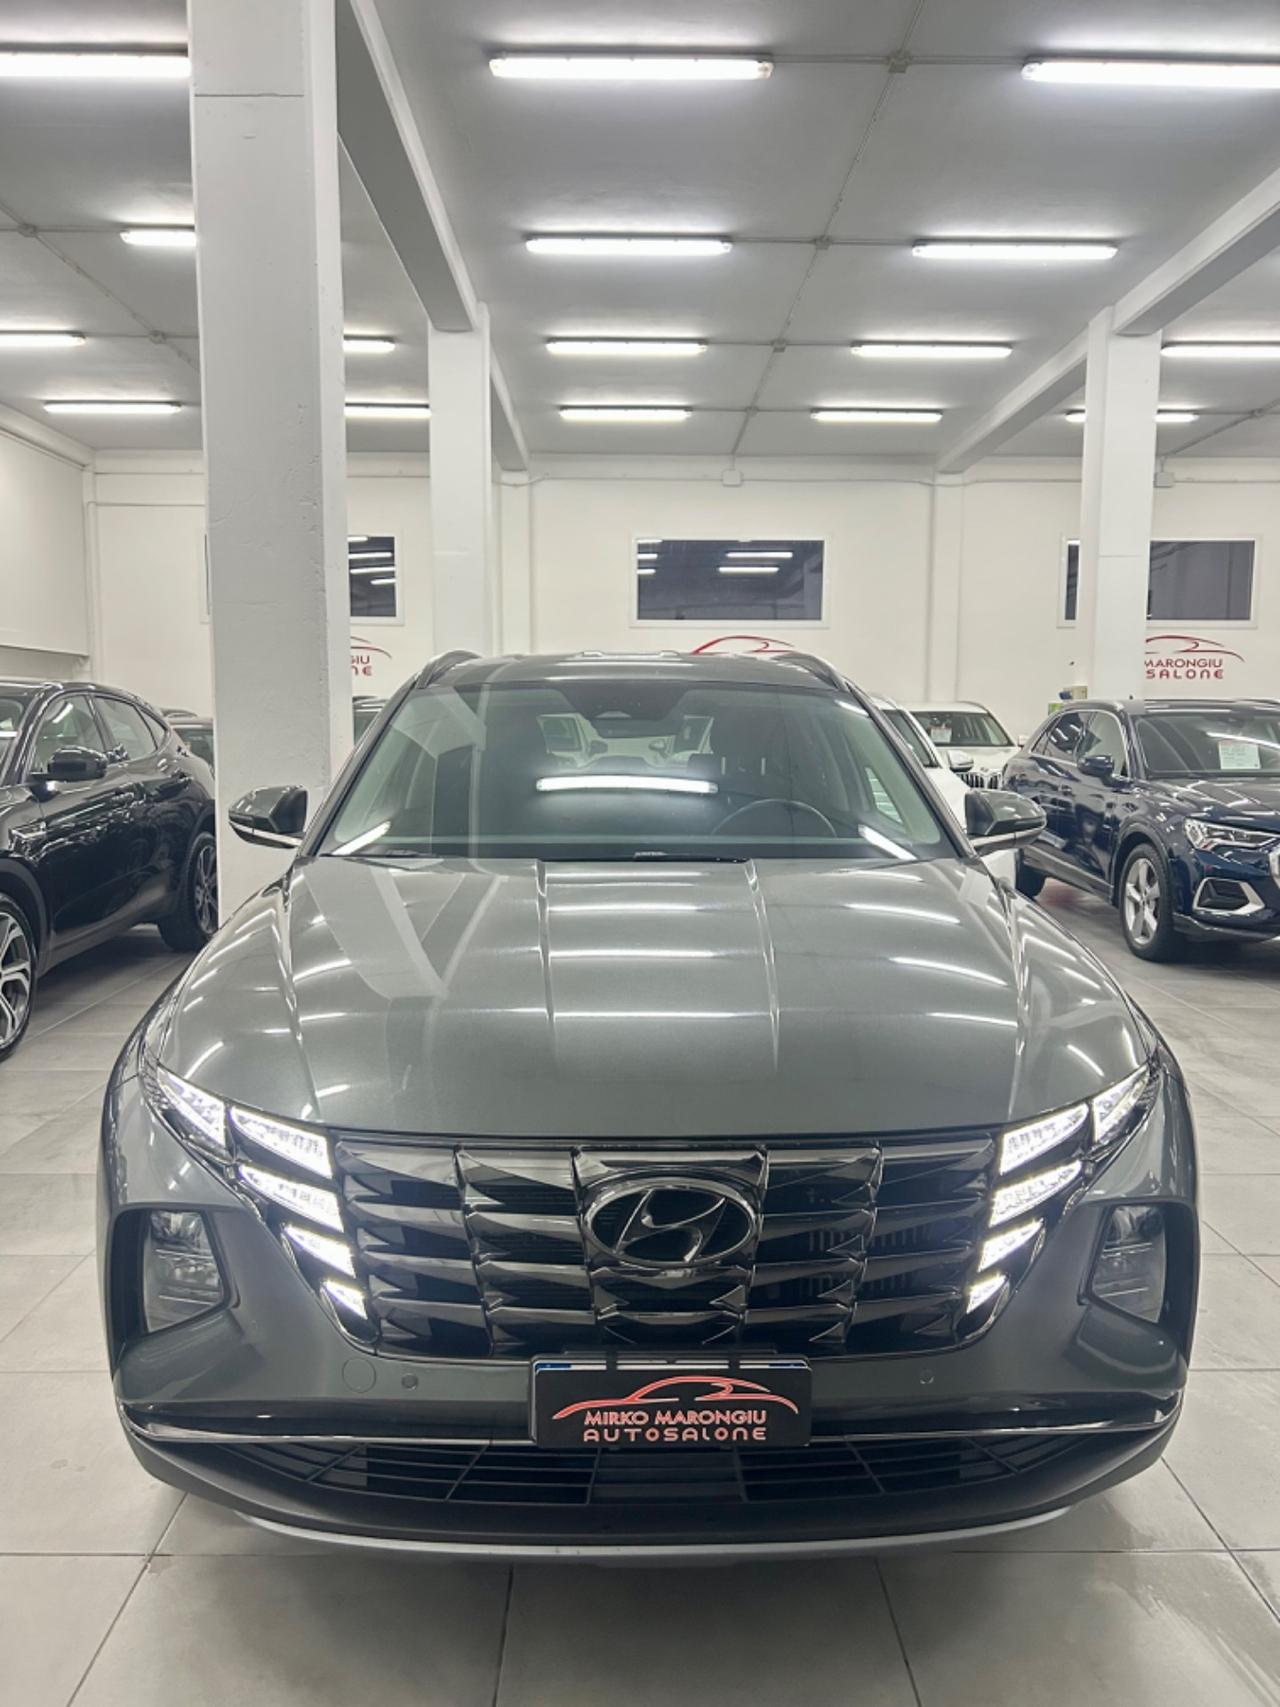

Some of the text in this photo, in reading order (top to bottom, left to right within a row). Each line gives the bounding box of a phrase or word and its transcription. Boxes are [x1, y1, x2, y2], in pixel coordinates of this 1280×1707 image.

[584, 1410, 767, 1426] MIRKO MARONGIU
[583, 1427, 767, 1442] AUTOSALONE
